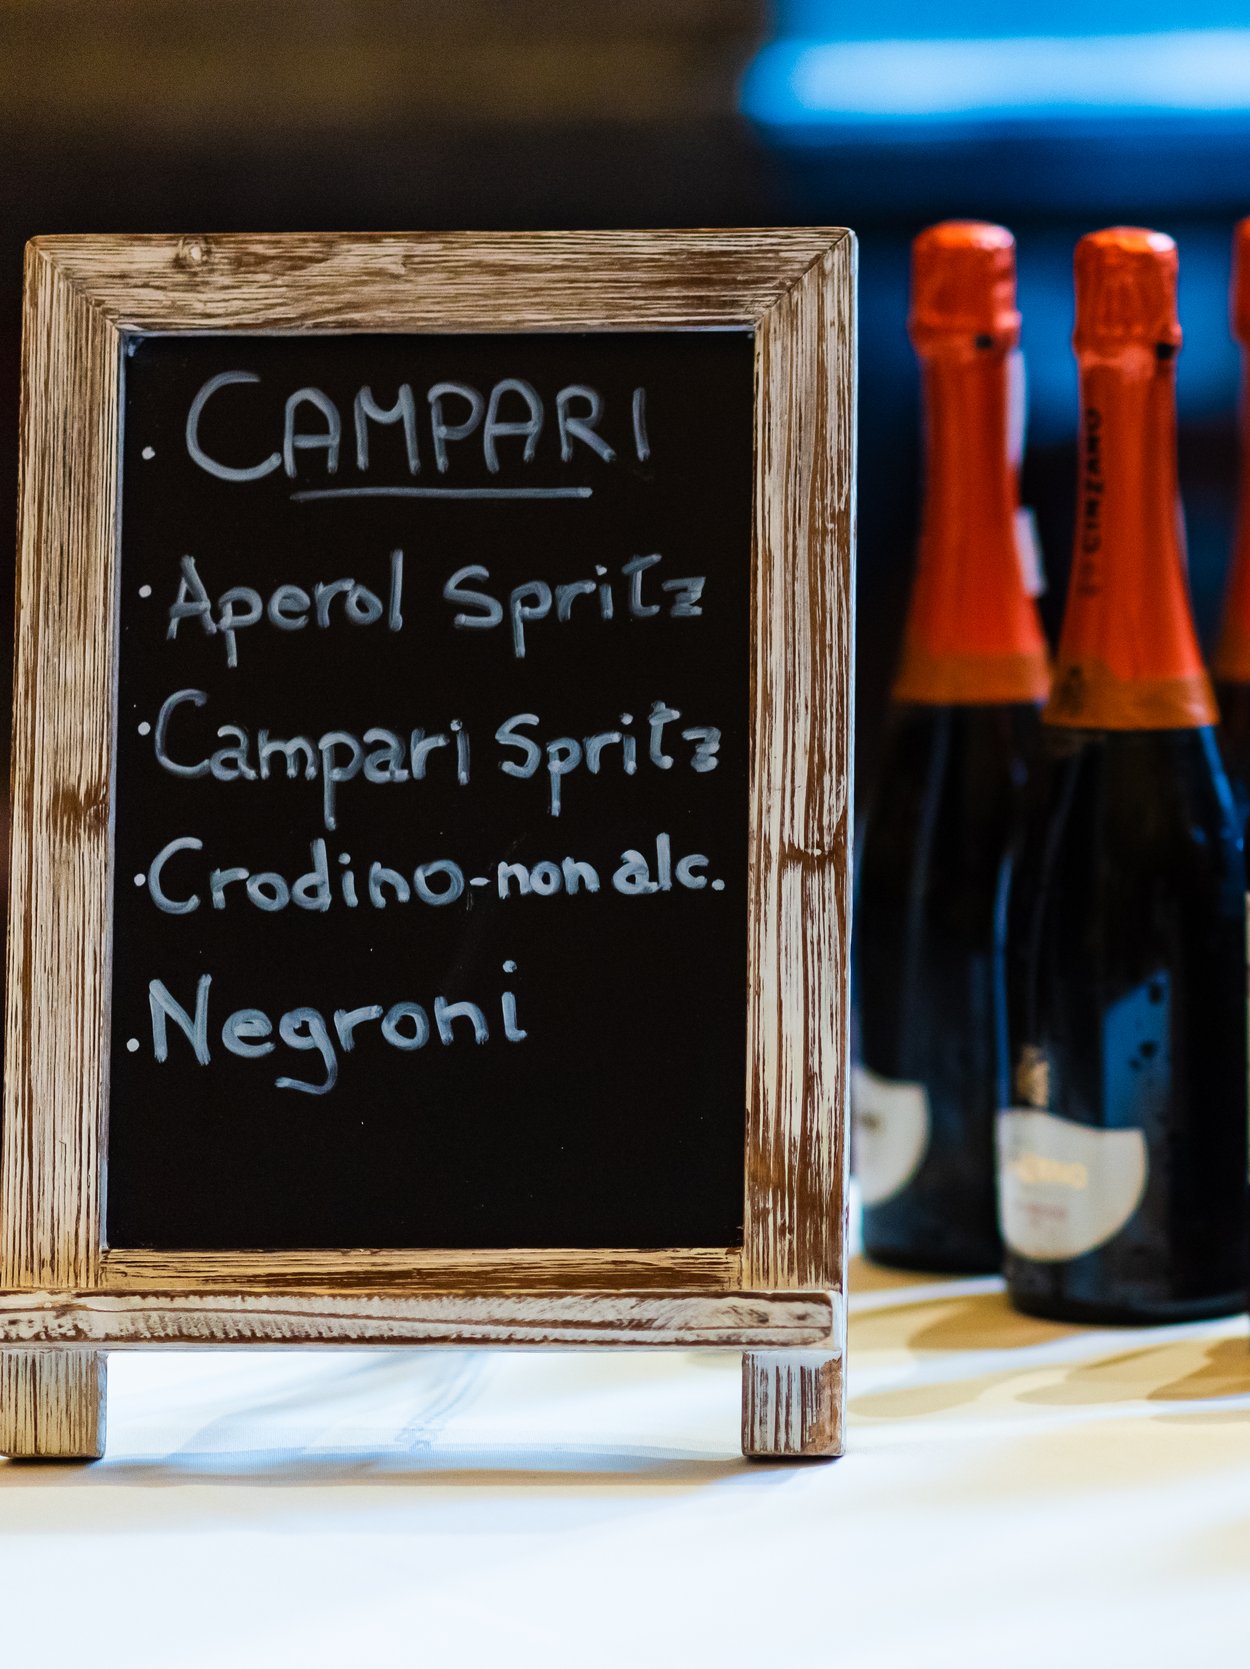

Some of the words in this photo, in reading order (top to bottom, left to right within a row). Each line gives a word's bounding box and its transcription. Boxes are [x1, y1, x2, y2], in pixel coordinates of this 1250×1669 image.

[185, 370, 651, 482] CAMPARI
[166, 549, 404, 668] Aperol
[443, 553, 706, 659] Spritz
[154, 688, 470, 831] Campari
[495, 701, 722, 817] Spritz
[612, 832, 726, 896] alc.
[148, 960, 528, 1095] Negroni
